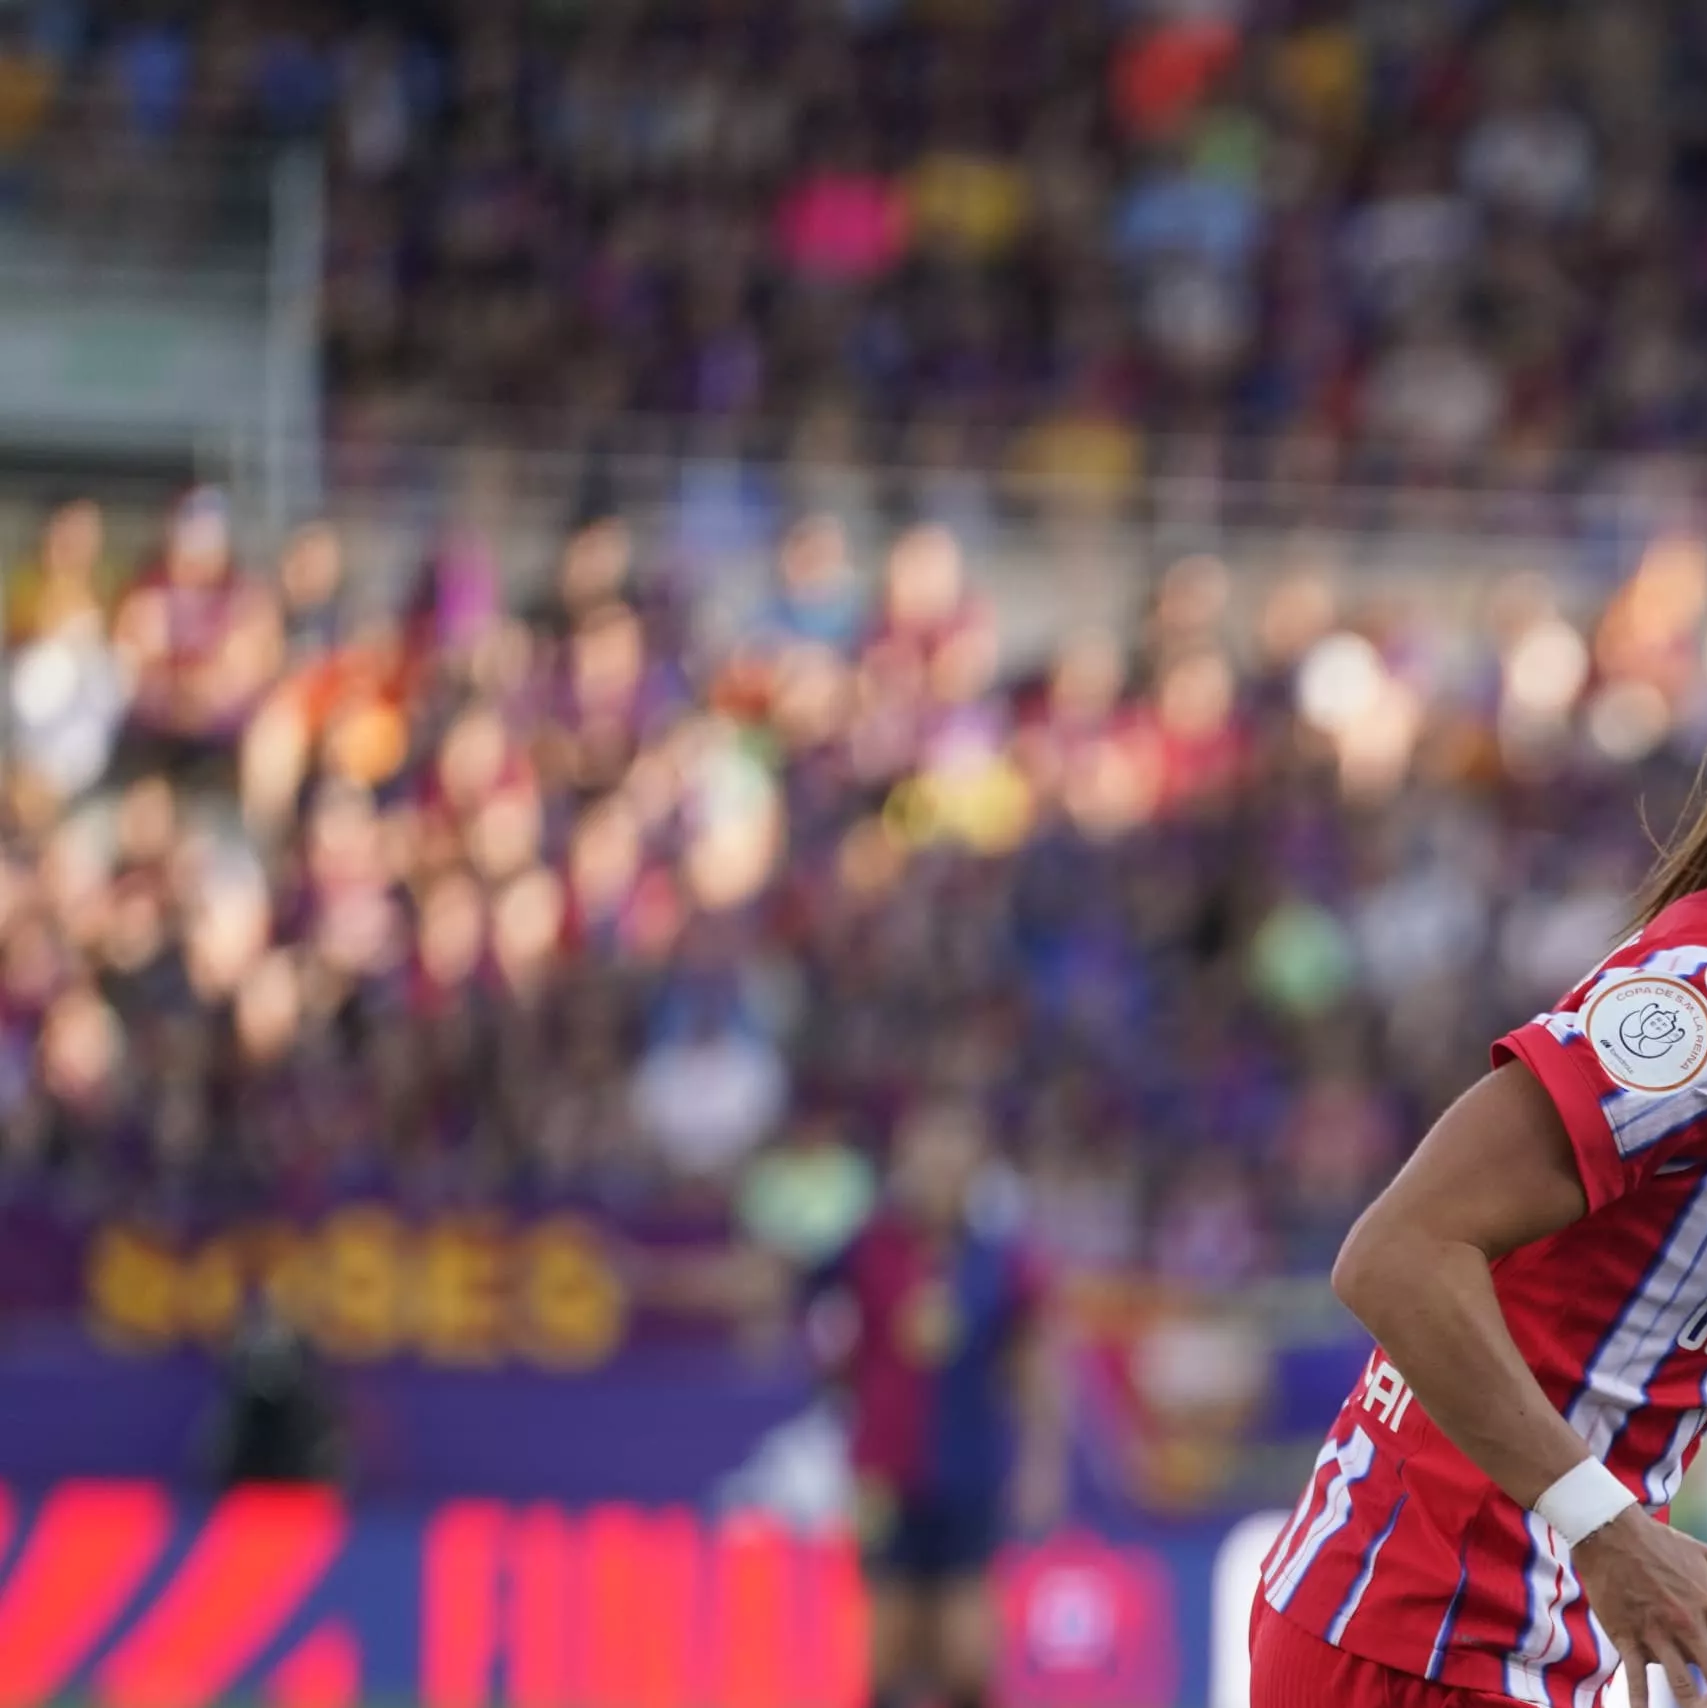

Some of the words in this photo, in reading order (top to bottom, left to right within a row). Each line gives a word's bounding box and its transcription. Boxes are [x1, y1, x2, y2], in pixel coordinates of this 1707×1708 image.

[1616, 986, 1653, 1003] COPA
[1655, 987, 1674, 1000] DE
[1692, 1015, 1704, 1032] LA
[1680, 1034, 1704, 1071] REINA
